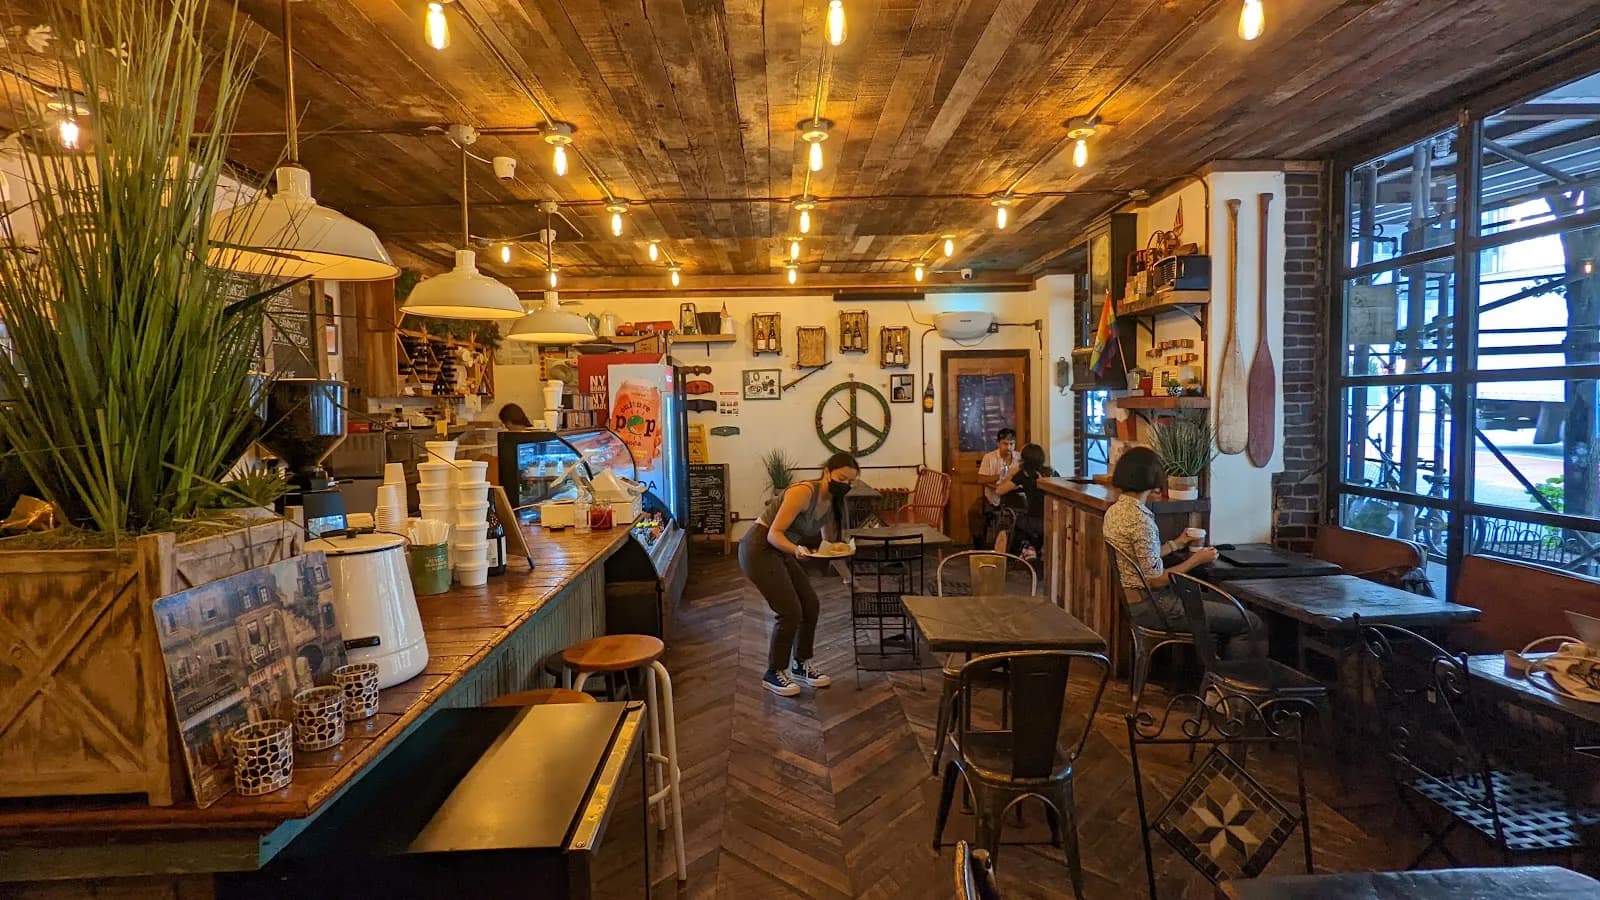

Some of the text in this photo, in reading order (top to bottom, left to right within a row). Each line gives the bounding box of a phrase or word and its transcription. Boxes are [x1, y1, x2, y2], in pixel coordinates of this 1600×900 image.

[590, 375, 606, 386] NY
[592, 394, 606, 404] NY
[621, 401, 651, 413] culture
